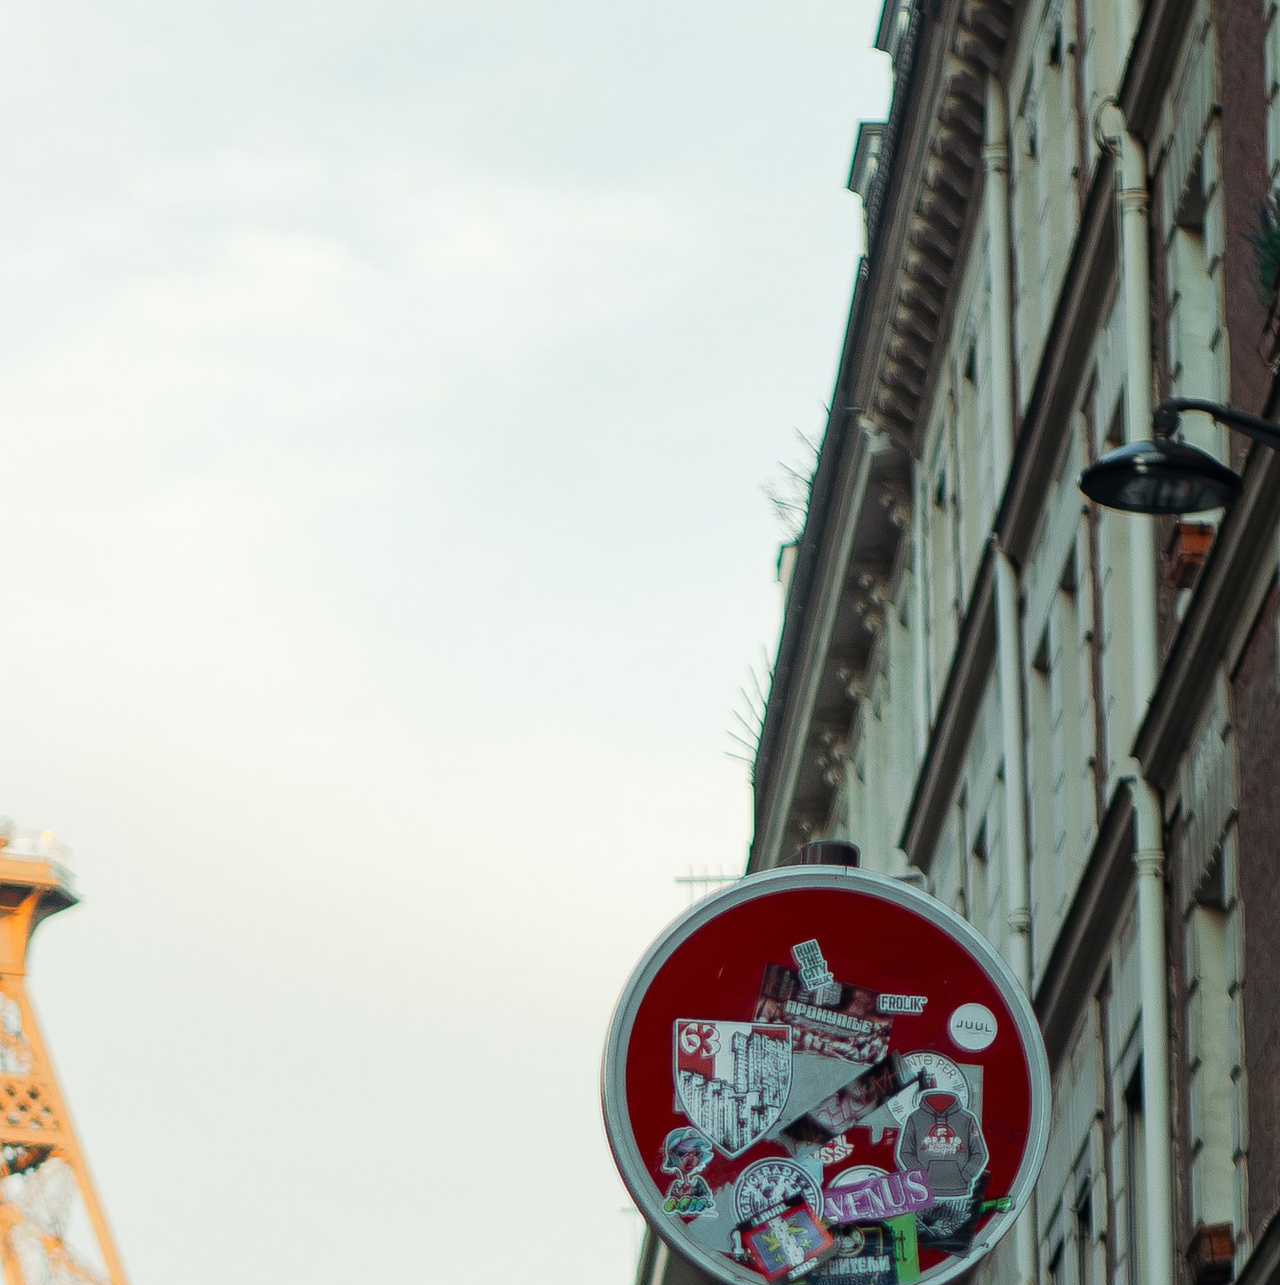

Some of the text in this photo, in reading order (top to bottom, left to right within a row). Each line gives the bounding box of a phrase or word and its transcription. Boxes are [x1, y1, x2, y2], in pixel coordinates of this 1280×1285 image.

[794, 940, 819, 958] RUN
[799, 952, 822, 968] THE
[802, 962, 827, 980] CITY
[956, 1019, 993, 1033] JUUL
[680, 1022, 721, 1058] 63
[824, 1169, 930, 1218] VENUS
